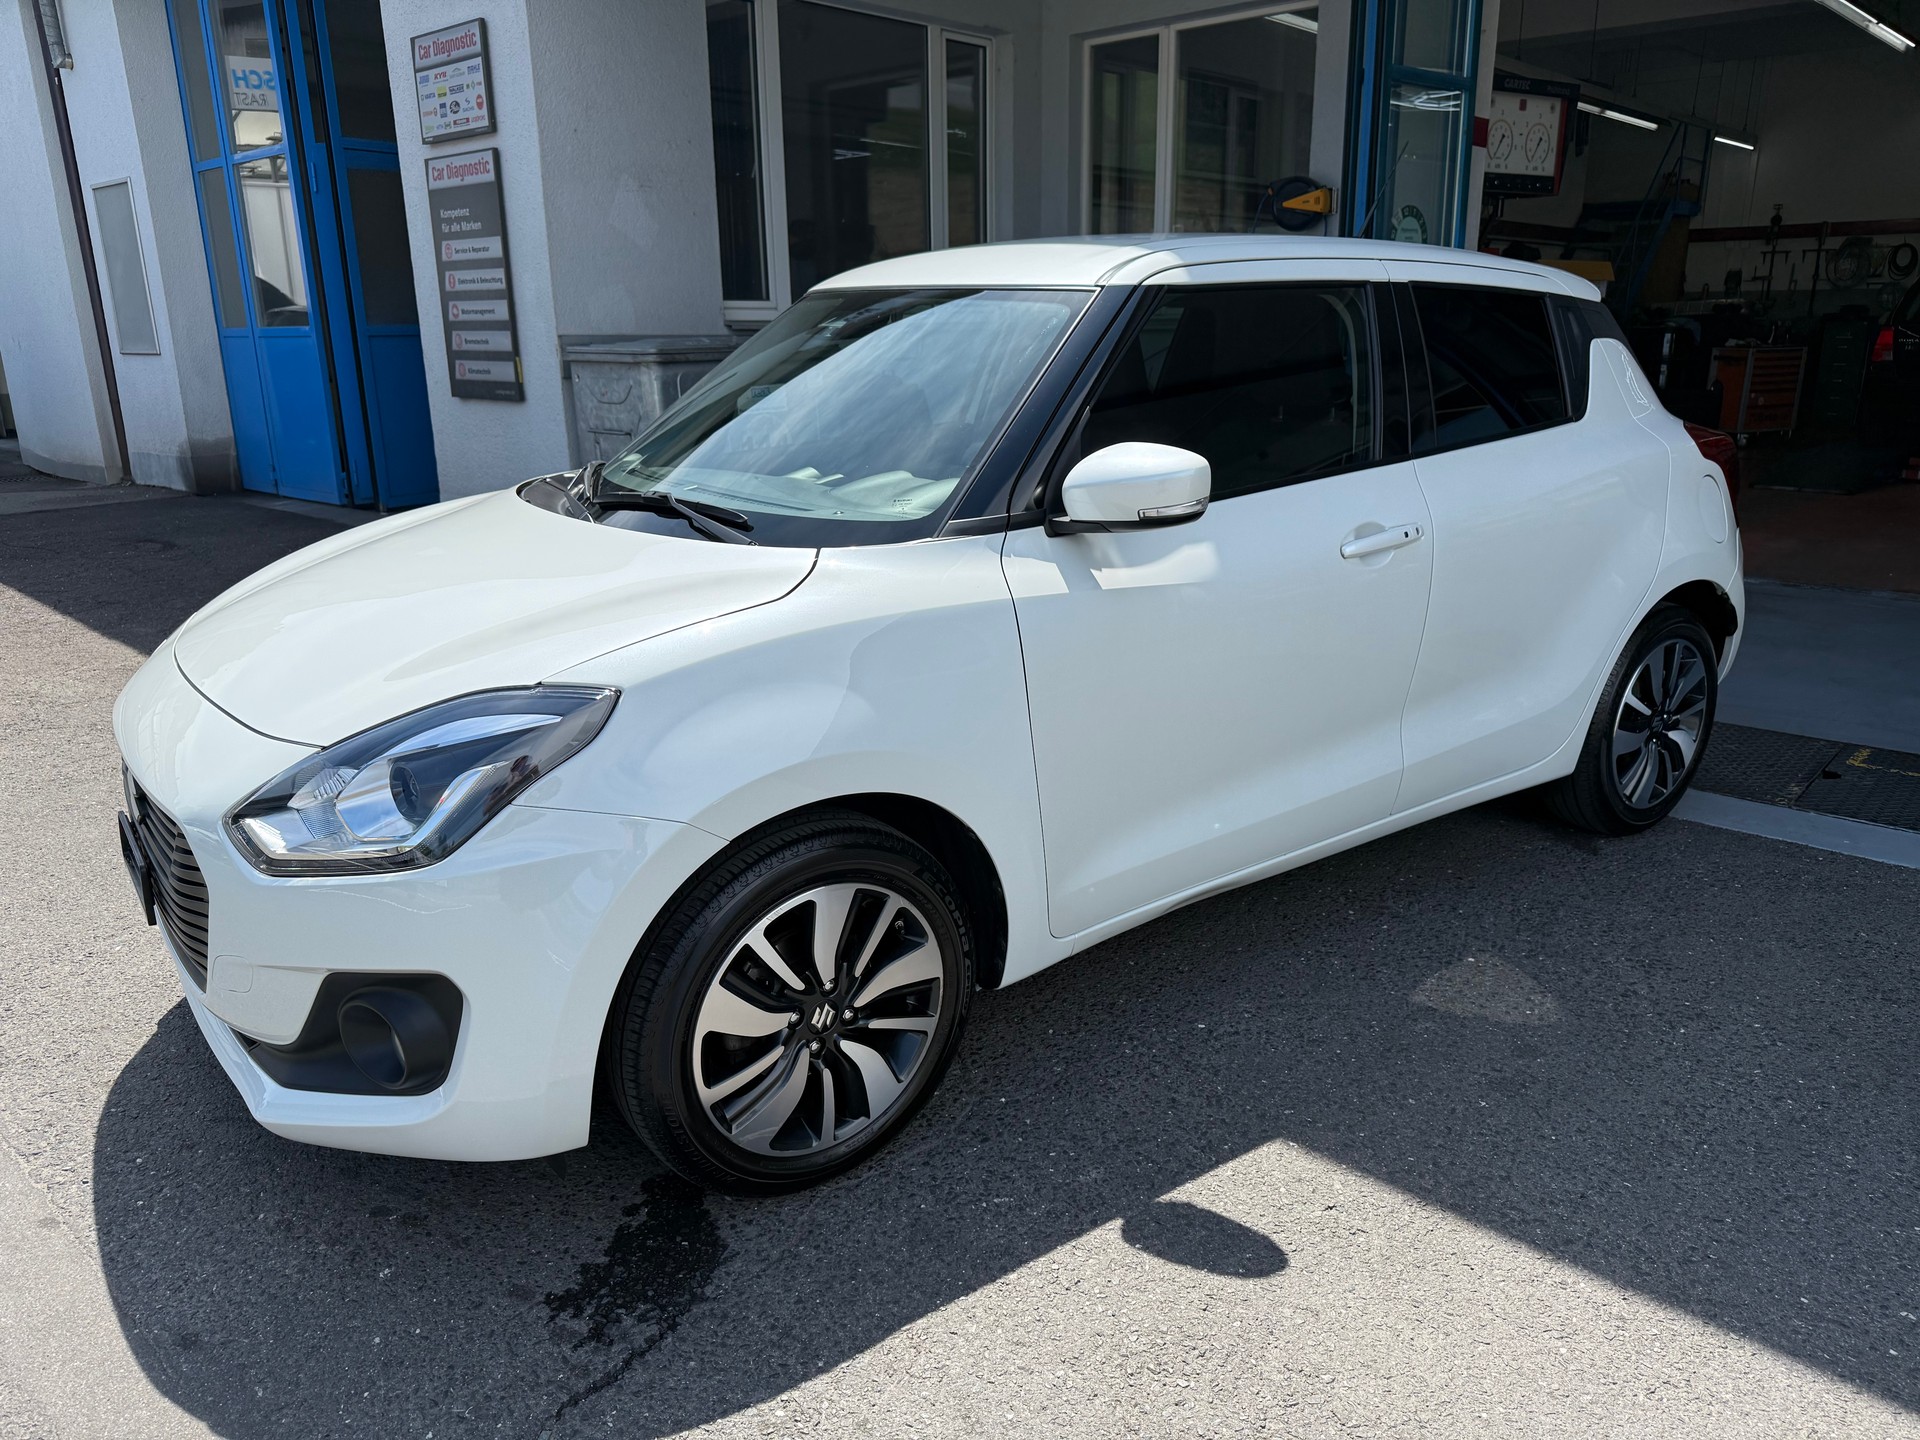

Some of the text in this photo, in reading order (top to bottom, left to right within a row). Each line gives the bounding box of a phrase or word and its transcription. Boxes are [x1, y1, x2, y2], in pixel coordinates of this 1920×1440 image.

[418, 29, 477, 60] Car Diagnostic
[431, 157, 491, 182] Car Diagnostic
[440, 208, 470, 219] Kompetenz
[441, 220, 482, 233] für alle Marken
